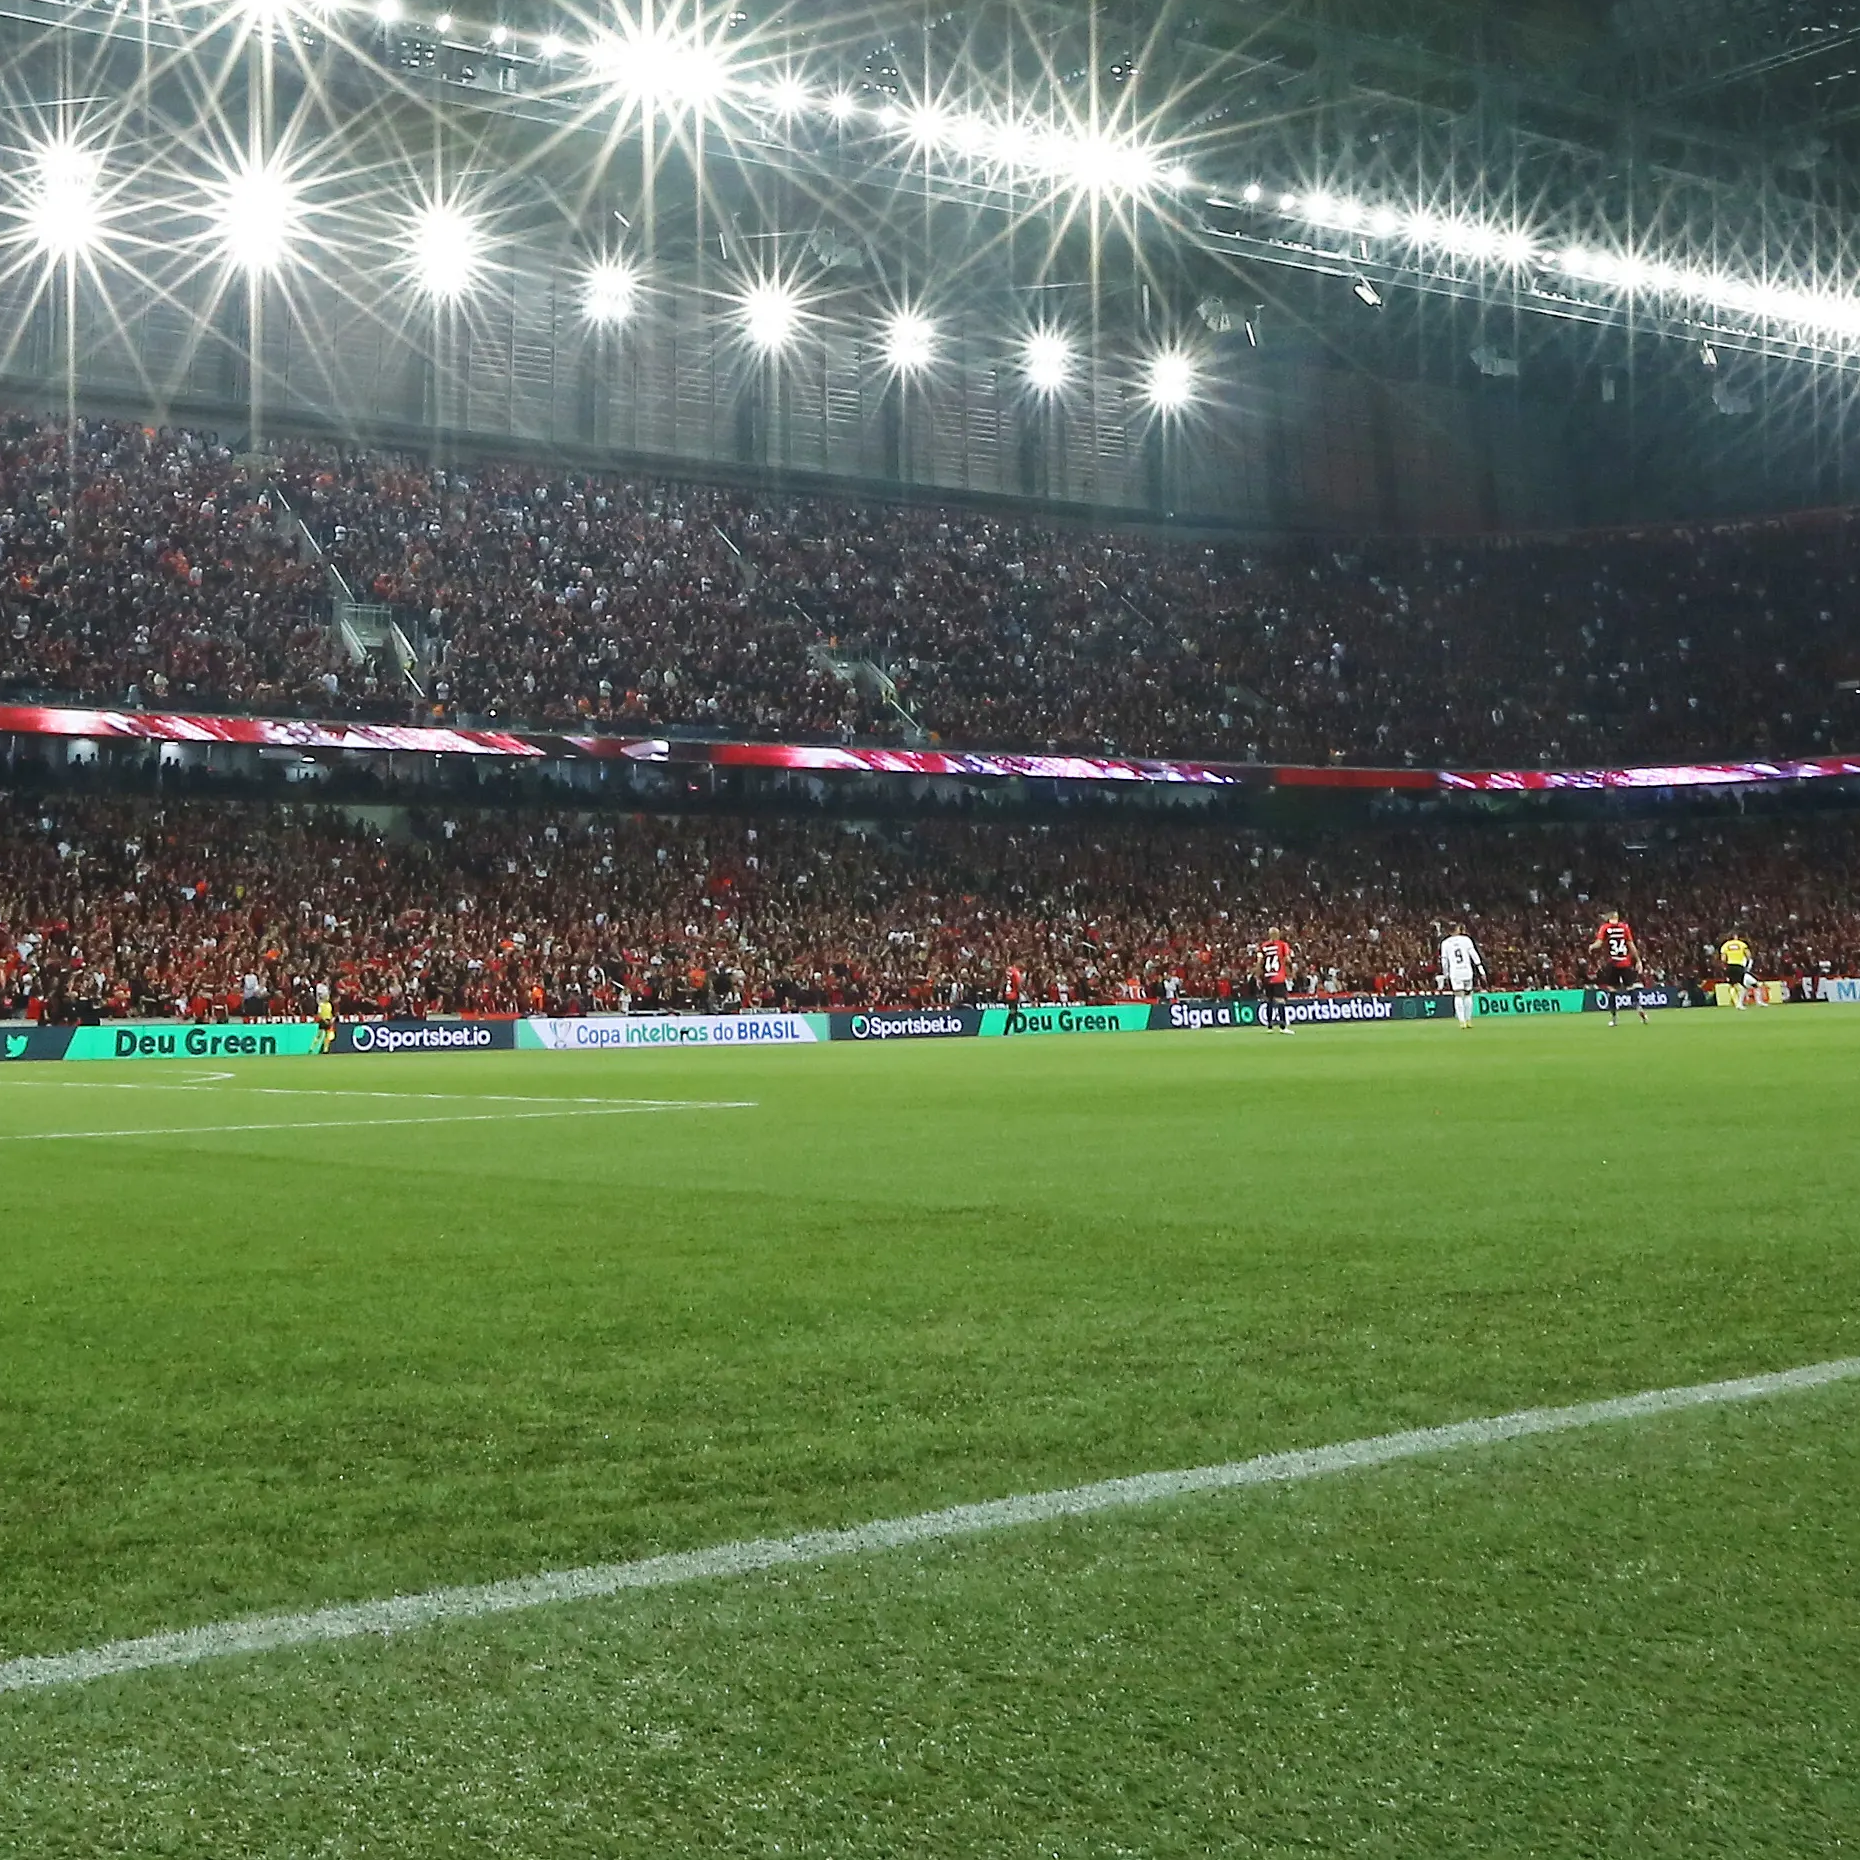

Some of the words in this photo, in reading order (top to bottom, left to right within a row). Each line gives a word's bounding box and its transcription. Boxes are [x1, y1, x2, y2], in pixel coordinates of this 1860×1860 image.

[1454, 948, 1464, 964] 9
[1608, 938, 1628, 956] 34
[1170, 1004, 1214, 1029] Siga
[1217, 1009, 1231, 1024] a
[1234, 1002, 1254, 1024] io
[1479, 996, 1511, 1015] Deu
[1514, 994, 1561, 1013] Green
[870, 1014, 963, 1038] Sportsbet.io
[1013, 1012, 1053, 1033] Deu
[1058, 1009, 1120, 1032] Green
[114, 1029, 175, 1057] Deu
[184, 1027, 277, 1057] Green
[376, 1026, 492, 1053] Sportsbet.io
[576, 1023, 621, 1048] Copa
[713, 1021, 734, 1040] do
[738, 1020, 801, 1040] BRASIL
